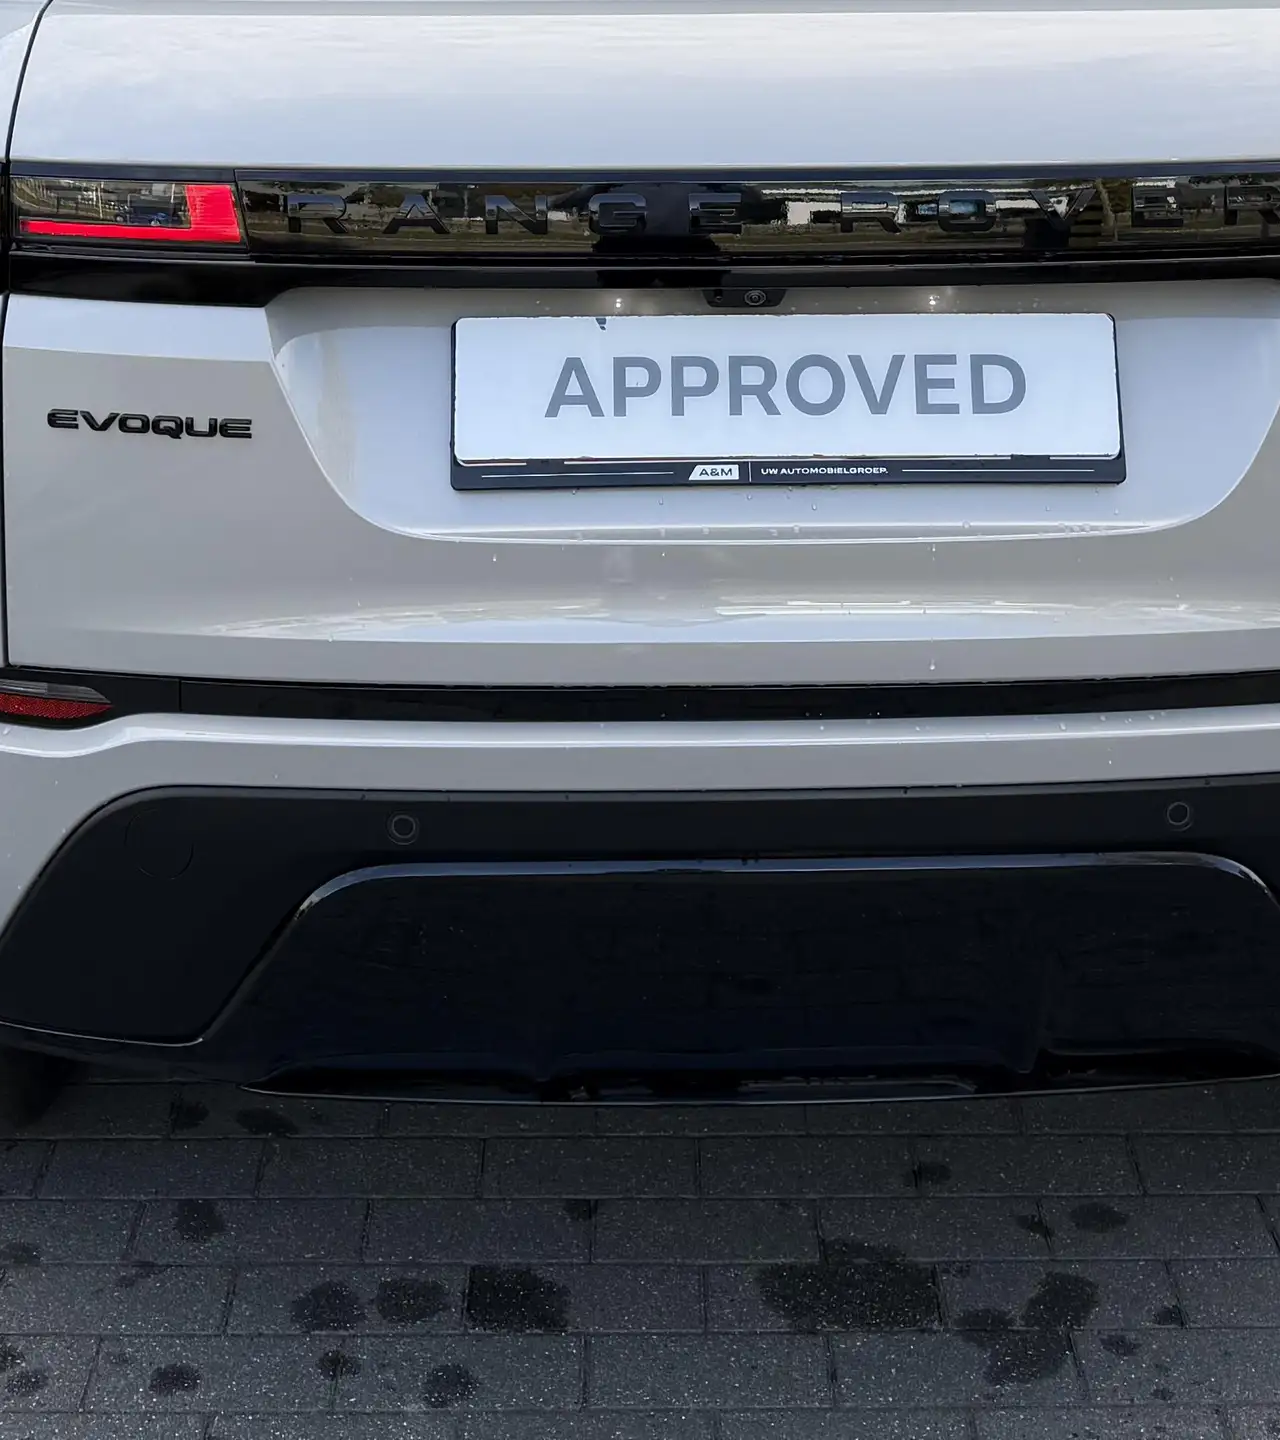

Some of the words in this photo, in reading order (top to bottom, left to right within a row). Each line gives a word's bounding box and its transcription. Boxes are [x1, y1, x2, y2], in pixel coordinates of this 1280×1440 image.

[284, 192, 744, 236] RANGE
[544, 353, 1027, 419] APPROVED
[46, 407, 254, 440] EVOQUE
[698, 464, 734, 479] A&M
[760, 467, 778, 475] UW
